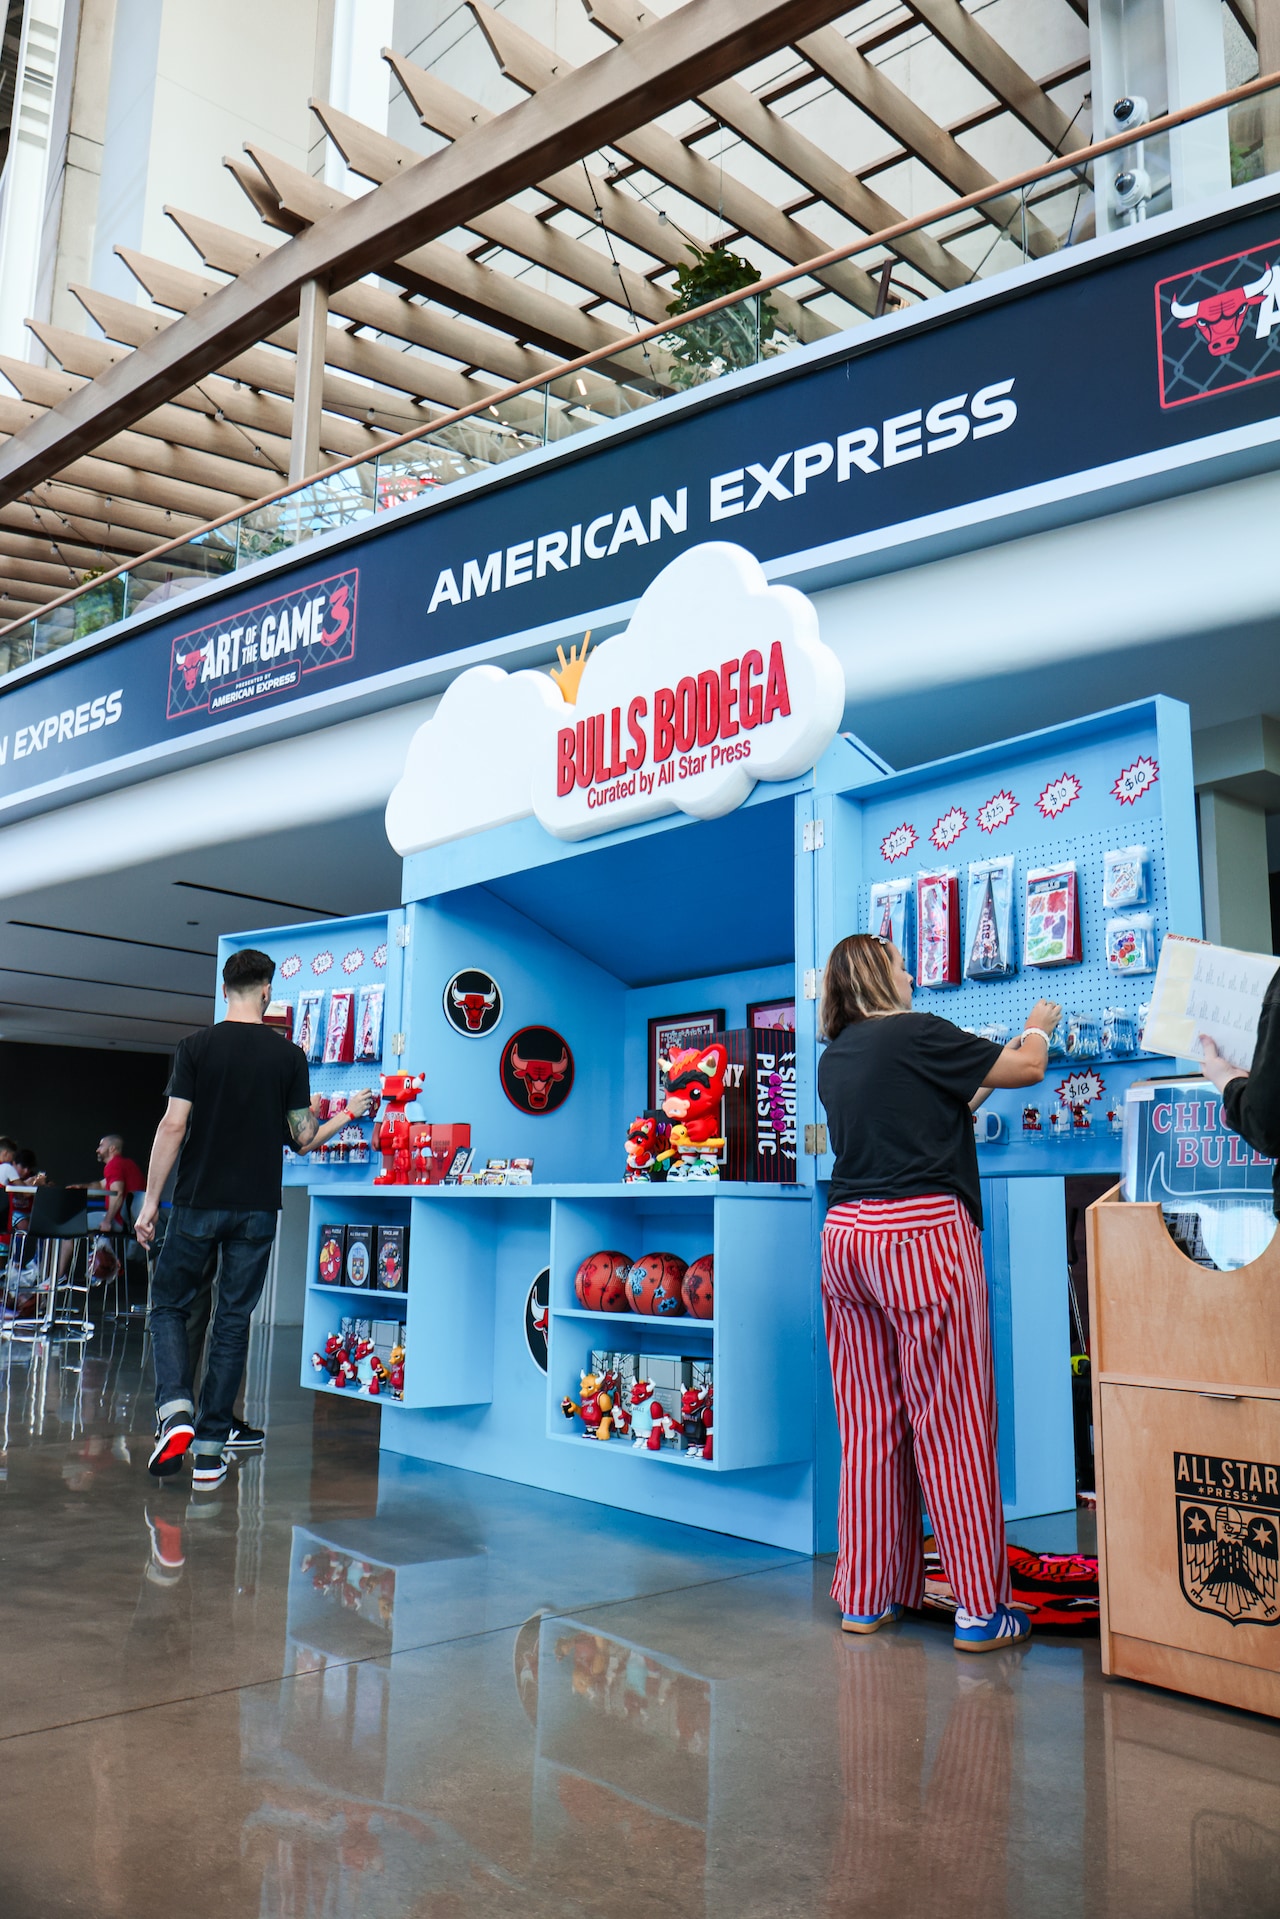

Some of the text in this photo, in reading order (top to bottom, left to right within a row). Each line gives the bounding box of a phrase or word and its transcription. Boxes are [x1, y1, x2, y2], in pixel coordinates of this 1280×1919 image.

[427, 378, 1018, 613] AMERICAN EXPRESS
[245, 625, 257, 644] OF
[260, 596, 326, 662] GAME
[201, 627, 244, 683] ART
[242, 643, 259, 665] THE
[212, 671, 297, 709] AMERICAN EXPRESS
[235, 675, 263, 689] PRESENTED
[13, 689, 123, 760] EXPRESS
[557, 640, 791, 797] BULLS BODEGA
[587, 740, 751, 809] Curated by All Star Press
[1124, 771, 1146, 791] $10
[985, 803, 1004, 822] $25
[1050, 787, 1067, 806] $10
[757, 1053, 777, 1156] PLASTIC
[1069, 1082, 1090, 1098] $18
[1176, 1134, 1279, 1168] BULL
[1177, 1455, 1279, 1496] ALL STAR
[1207, 1486, 1249, 1502] PRESS
